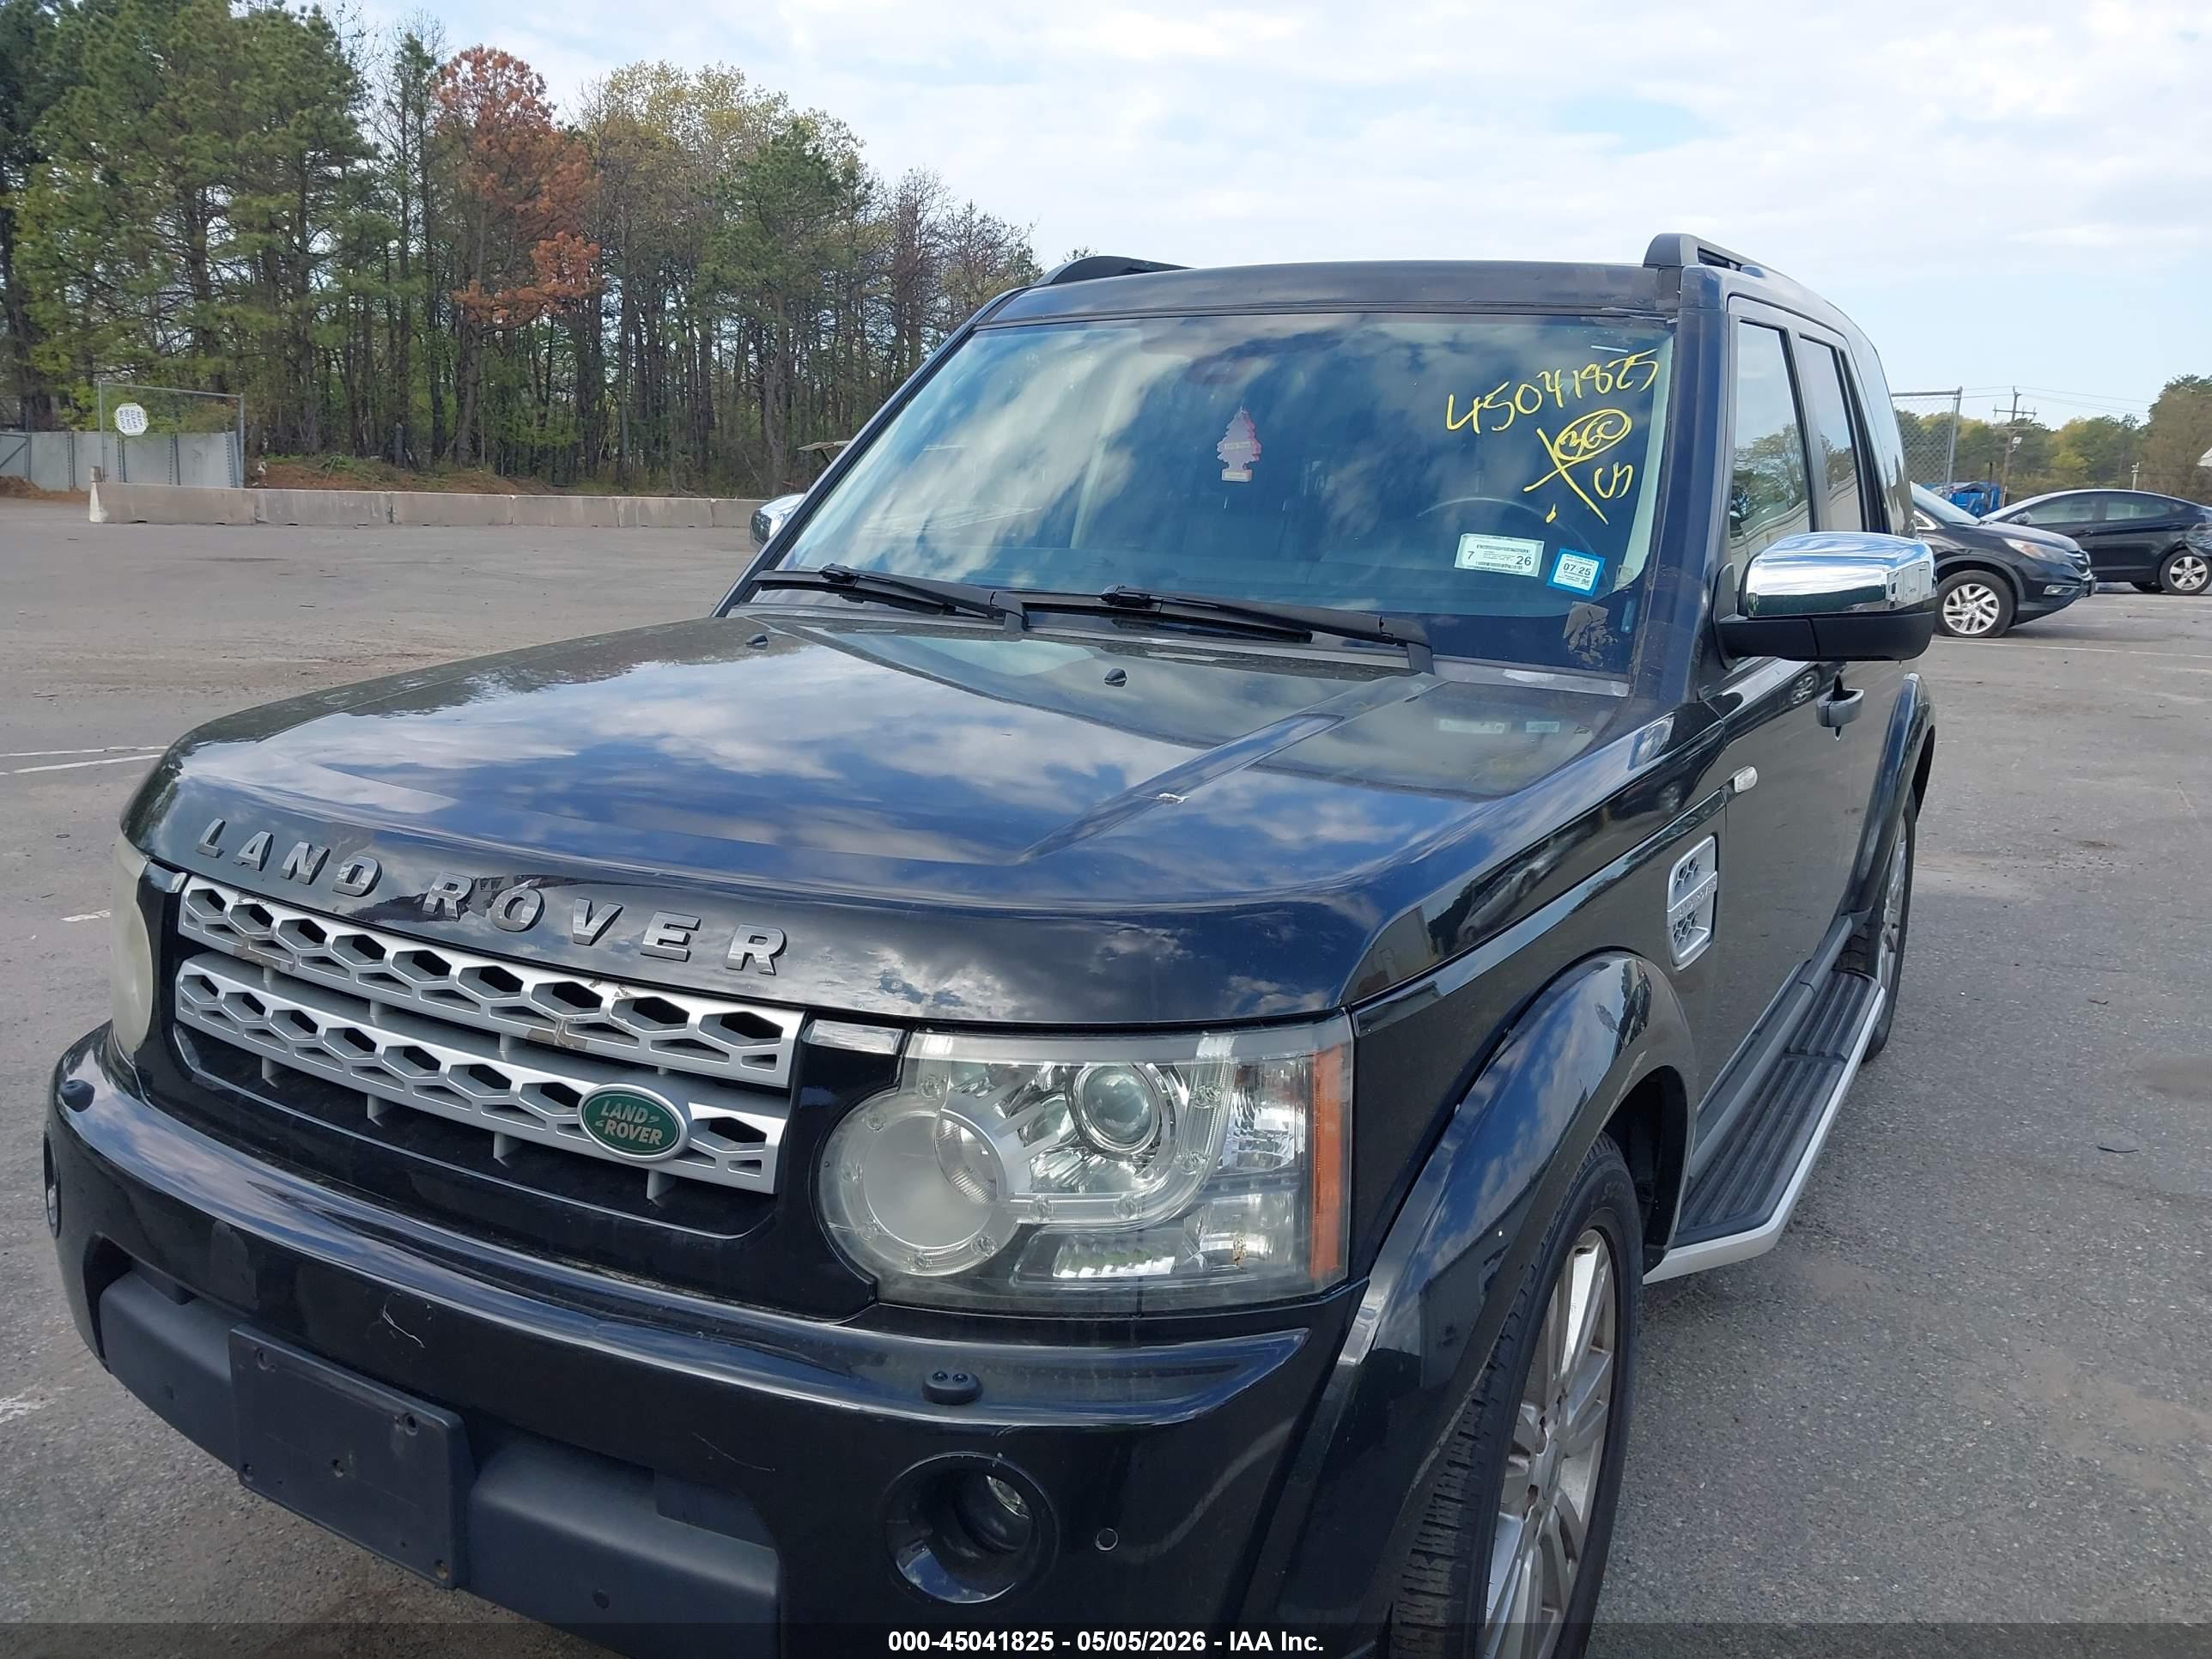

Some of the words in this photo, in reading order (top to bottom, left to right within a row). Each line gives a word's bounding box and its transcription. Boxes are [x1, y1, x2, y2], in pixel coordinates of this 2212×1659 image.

[1446, 348, 1659, 434] 45041825
[1467, 550, 1475, 560] 7
[1516, 556, 1532, 567] 26
[196, 817, 383, 897] LAND
[421, 872, 787, 975] ROVER
[600, 1100, 648, 1124] LAND
[604, 1119, 663, 1146] ROVER
